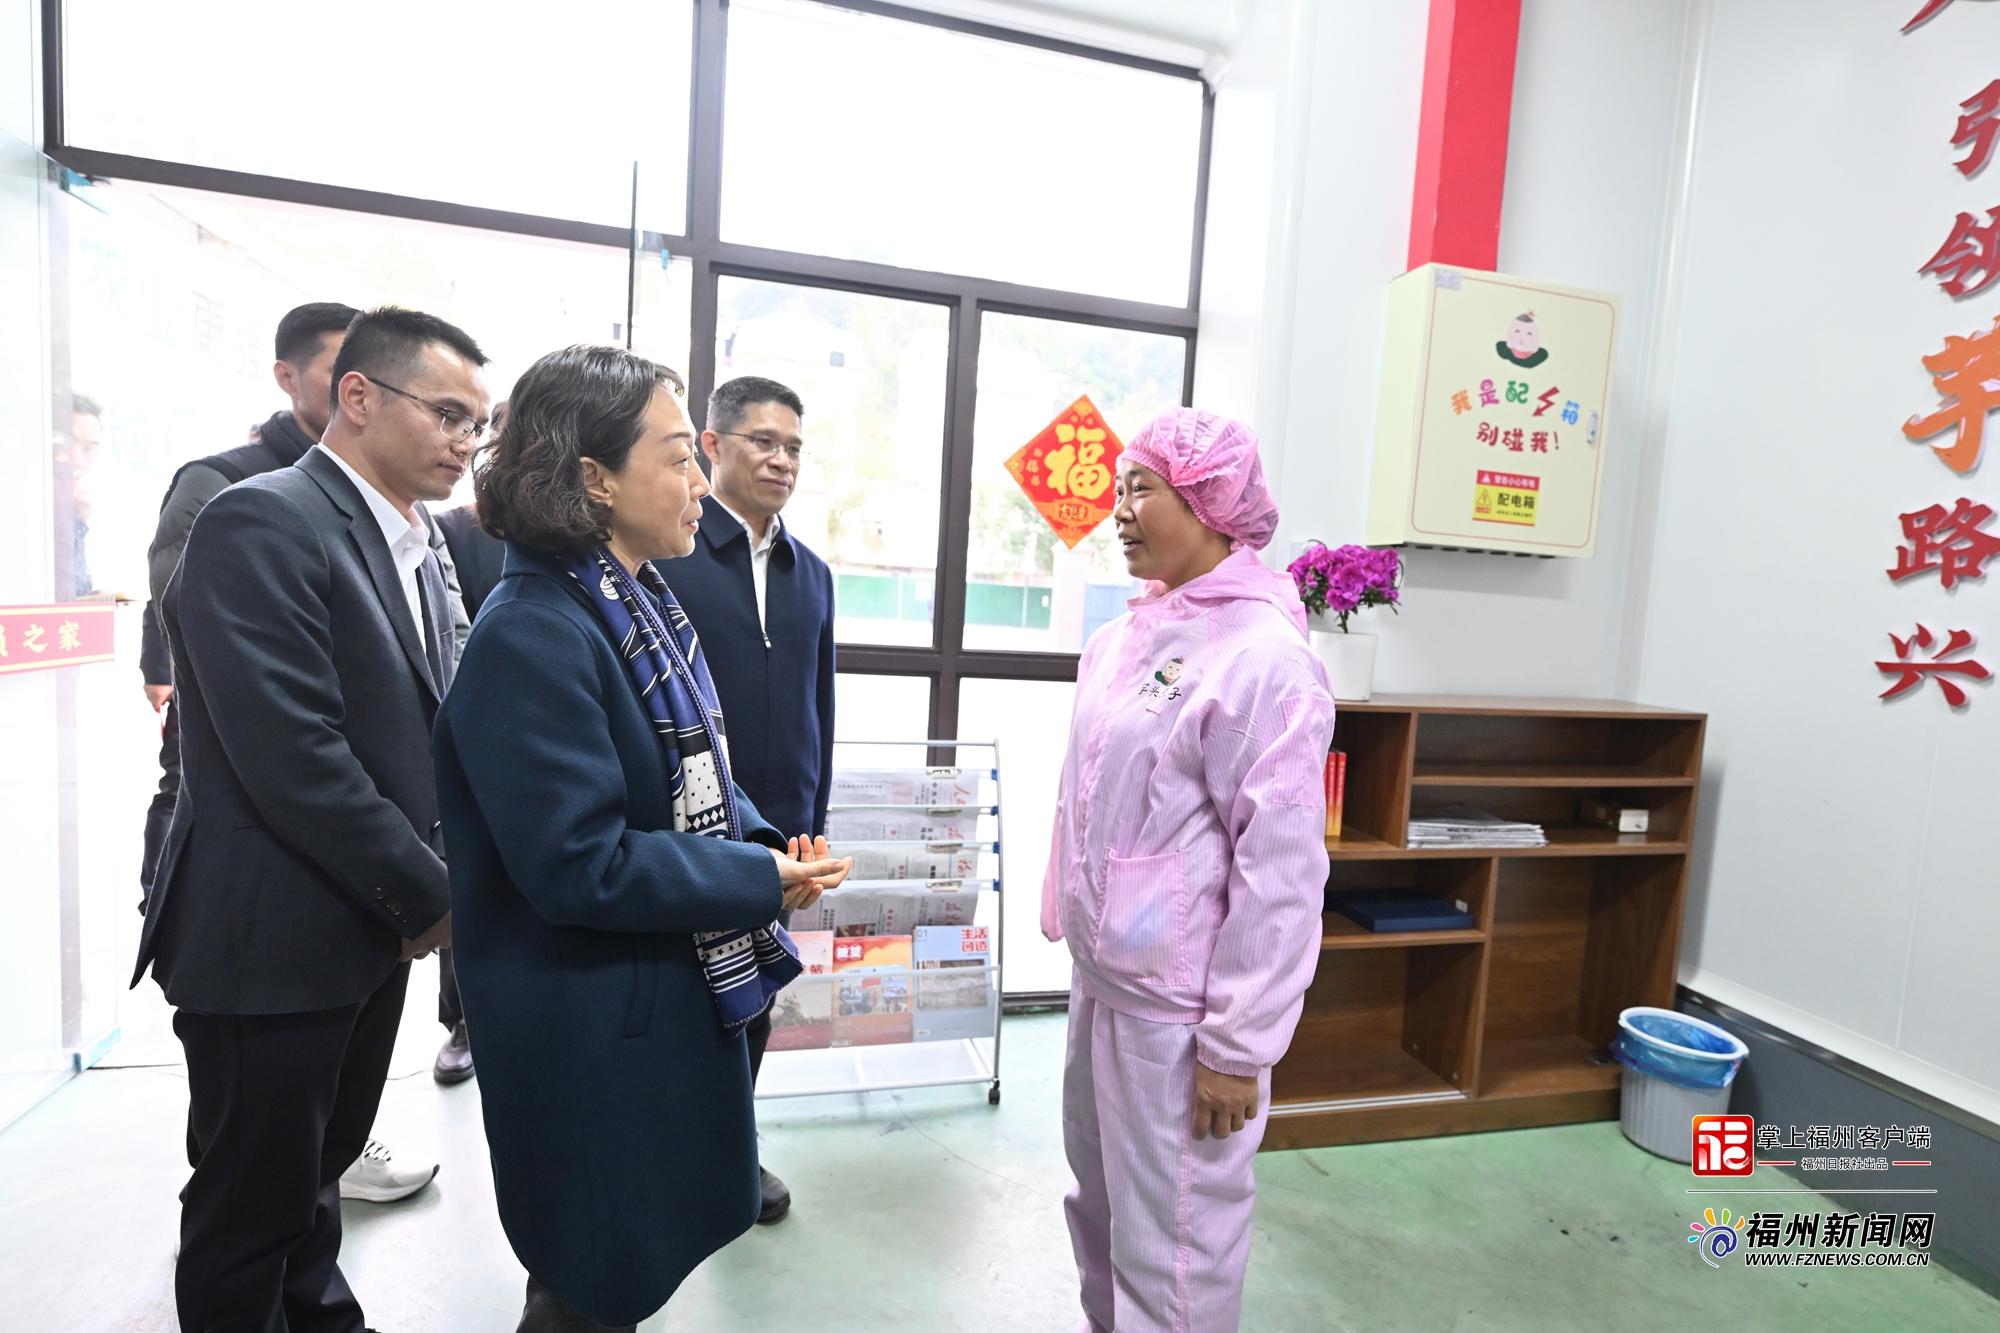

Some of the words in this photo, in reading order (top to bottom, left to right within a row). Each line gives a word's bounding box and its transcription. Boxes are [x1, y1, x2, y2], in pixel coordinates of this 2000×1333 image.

[1044, 423, 1112, 500] 福
[1497, 492, 1535, 509] 配电箱
[917, 929, 928, 938] 01
[961, 928, 988, 939] 生活
